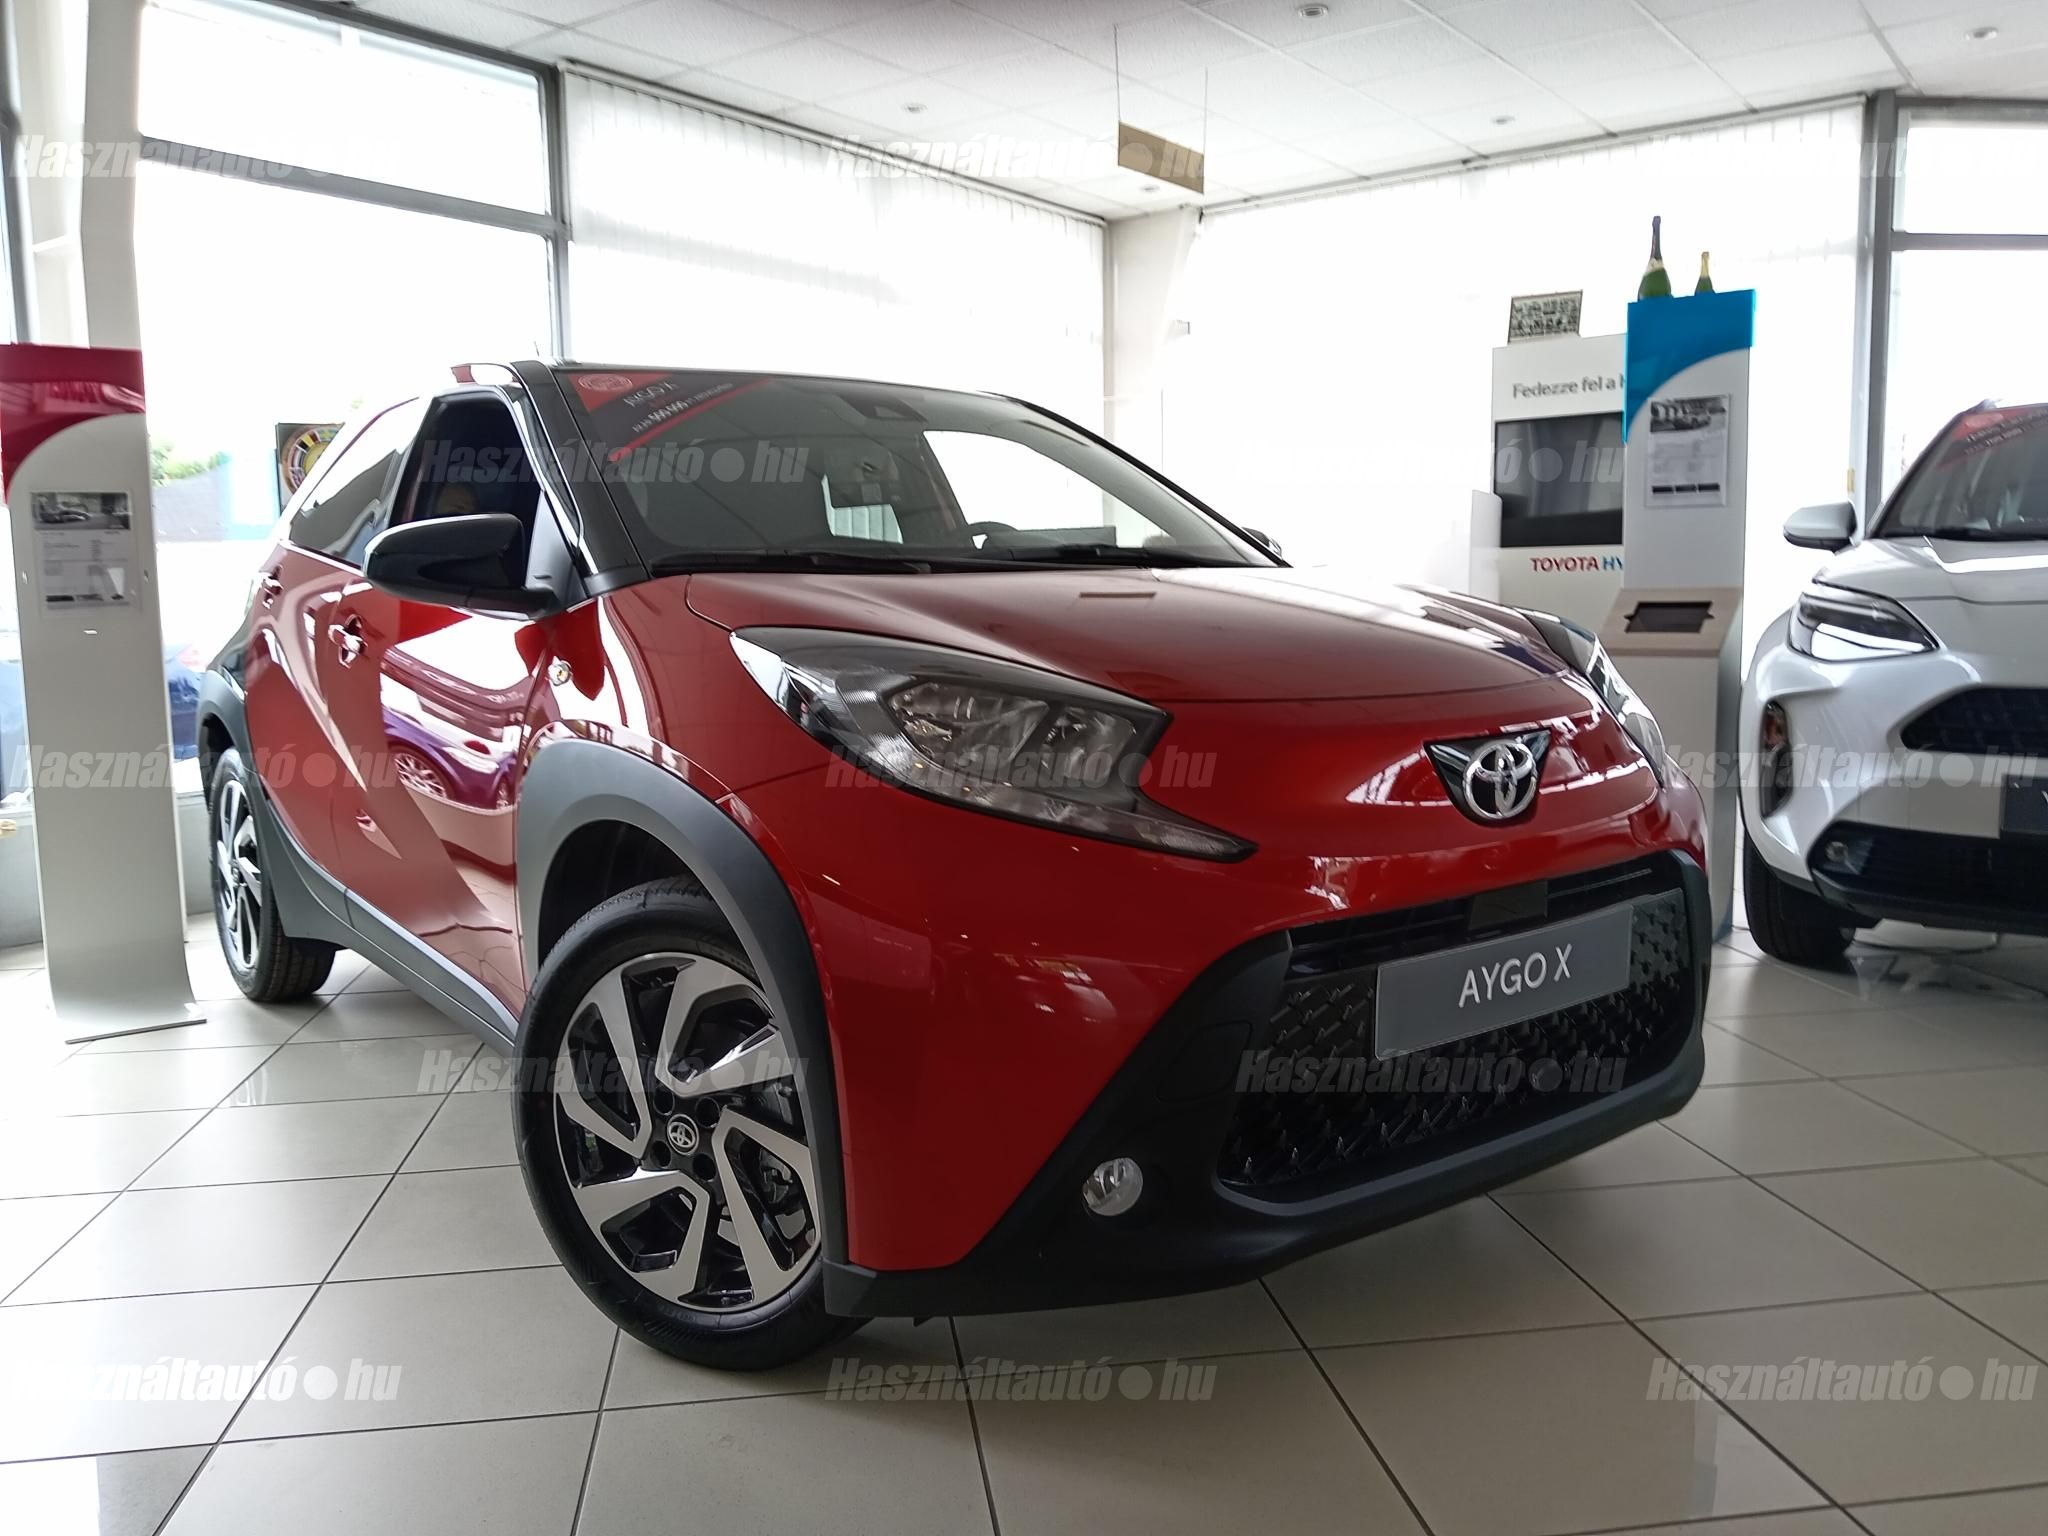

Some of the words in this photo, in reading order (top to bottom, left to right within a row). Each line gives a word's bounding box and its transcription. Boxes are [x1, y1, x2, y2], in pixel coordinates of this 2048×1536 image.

[1512, 381, 1578, 399] Fedezze
[1582, 375, 1602, 392] fel
[1606, 377, 1616, 390] a
[1529, 555, 1599, 572] TOYOTA
[1458, 951, 1547, 1009] AYGO
[1553, 943, 1573, 982] X
